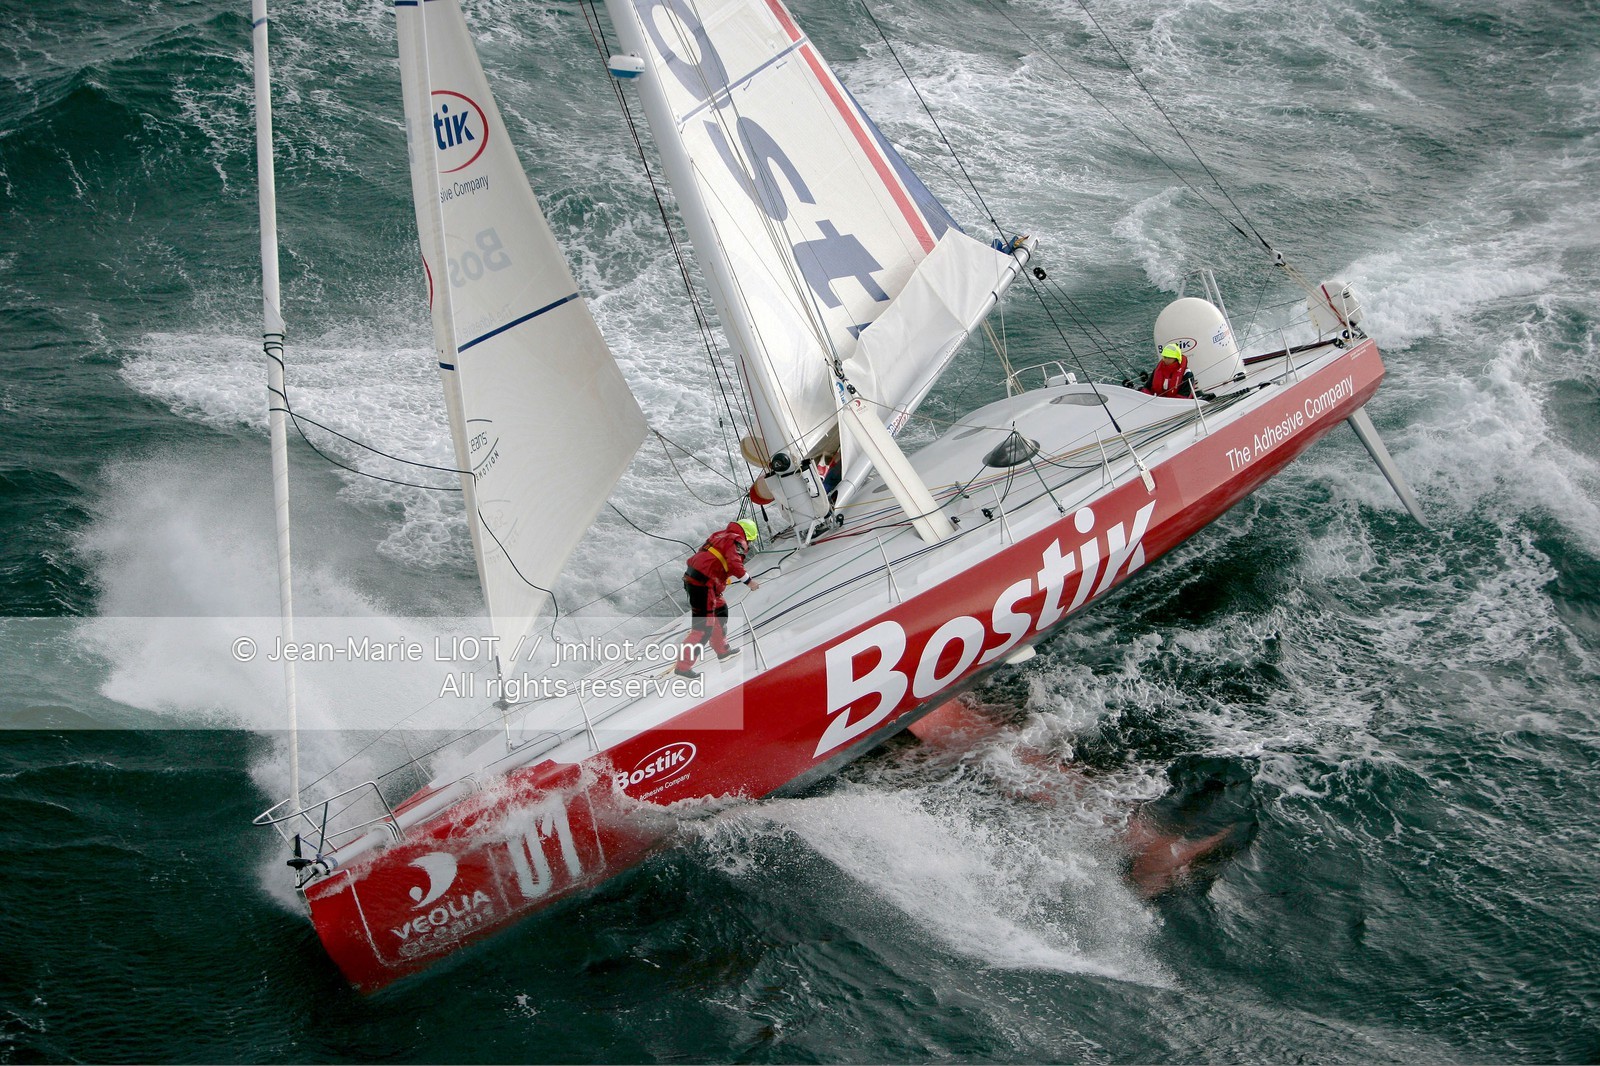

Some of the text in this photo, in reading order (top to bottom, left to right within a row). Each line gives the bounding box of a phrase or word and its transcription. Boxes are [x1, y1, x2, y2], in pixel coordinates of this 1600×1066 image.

[453, 174, 489, 197] Company
[1225, 375, 1353, 471] The Adhesive Company
[812, 500, 1156, 759] Bostik
[612, 747, 686, 793] Bostik
[664, 772, 691, 789] Company
[390, 890, 491, 939] VEOLIA
